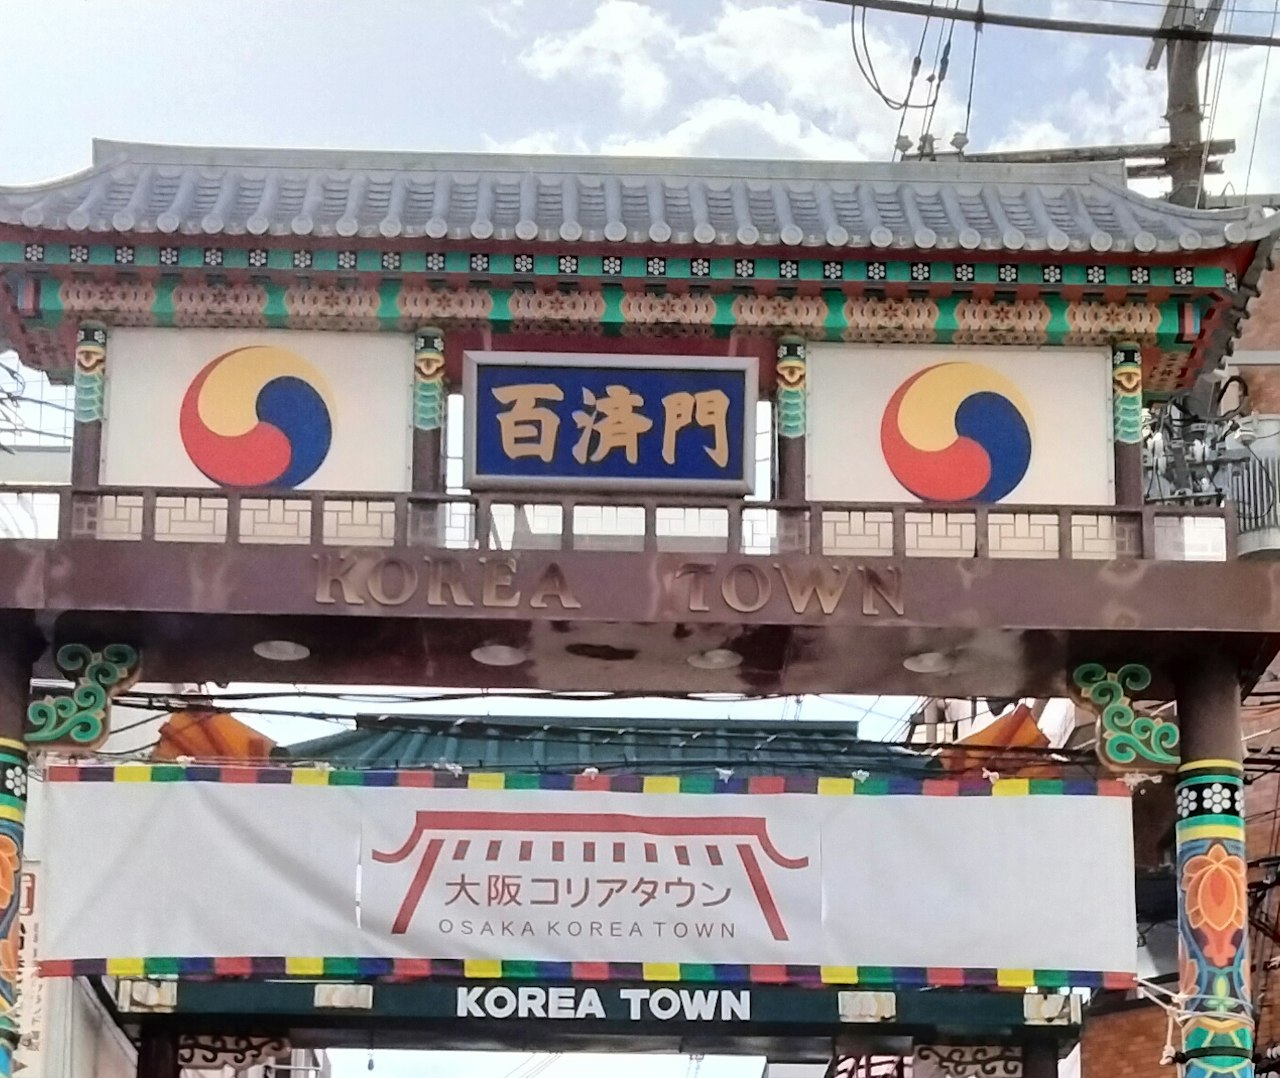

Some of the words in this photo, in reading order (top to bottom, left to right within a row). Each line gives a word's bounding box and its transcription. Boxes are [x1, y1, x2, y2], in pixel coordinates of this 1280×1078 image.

[491, 383, 731, 468] 百済門
[314, 551, 582, 611] KOREA
[677, 563, 906, 617] TOWN
[444, 872, 733, 909] 大阪コリアタウン
[438, 919, 535, 936] OSAKA
[547, 920, 643, 937] KOREA
[655, 921, 737, 938] TOWN
[456, 986, 606, 1019] KOREA
[620, 988, 751, 1021] TOWN
